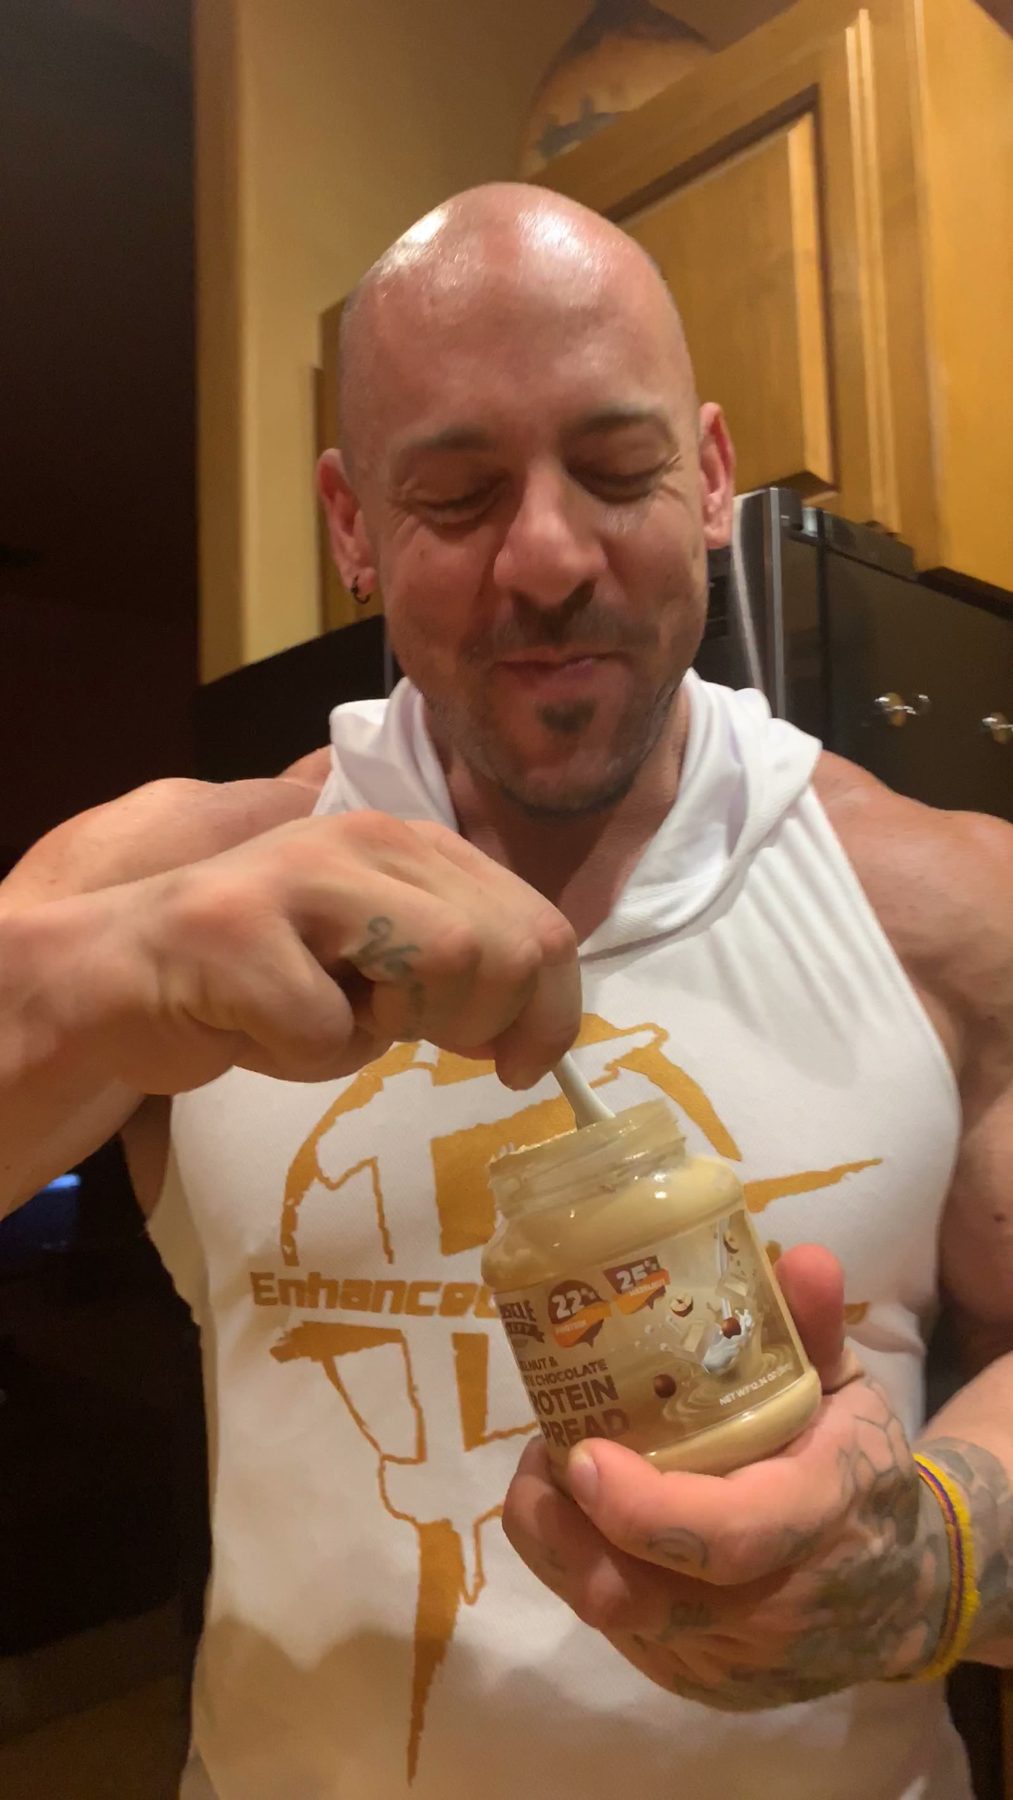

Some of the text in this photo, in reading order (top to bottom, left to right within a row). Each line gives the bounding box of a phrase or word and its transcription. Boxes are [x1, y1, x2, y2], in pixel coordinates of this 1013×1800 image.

[548, 1356, 558, 1367] &
[535, 1357, 609, 1387] CHOCOLATE
[719, 1392, 736, 1406] NET
